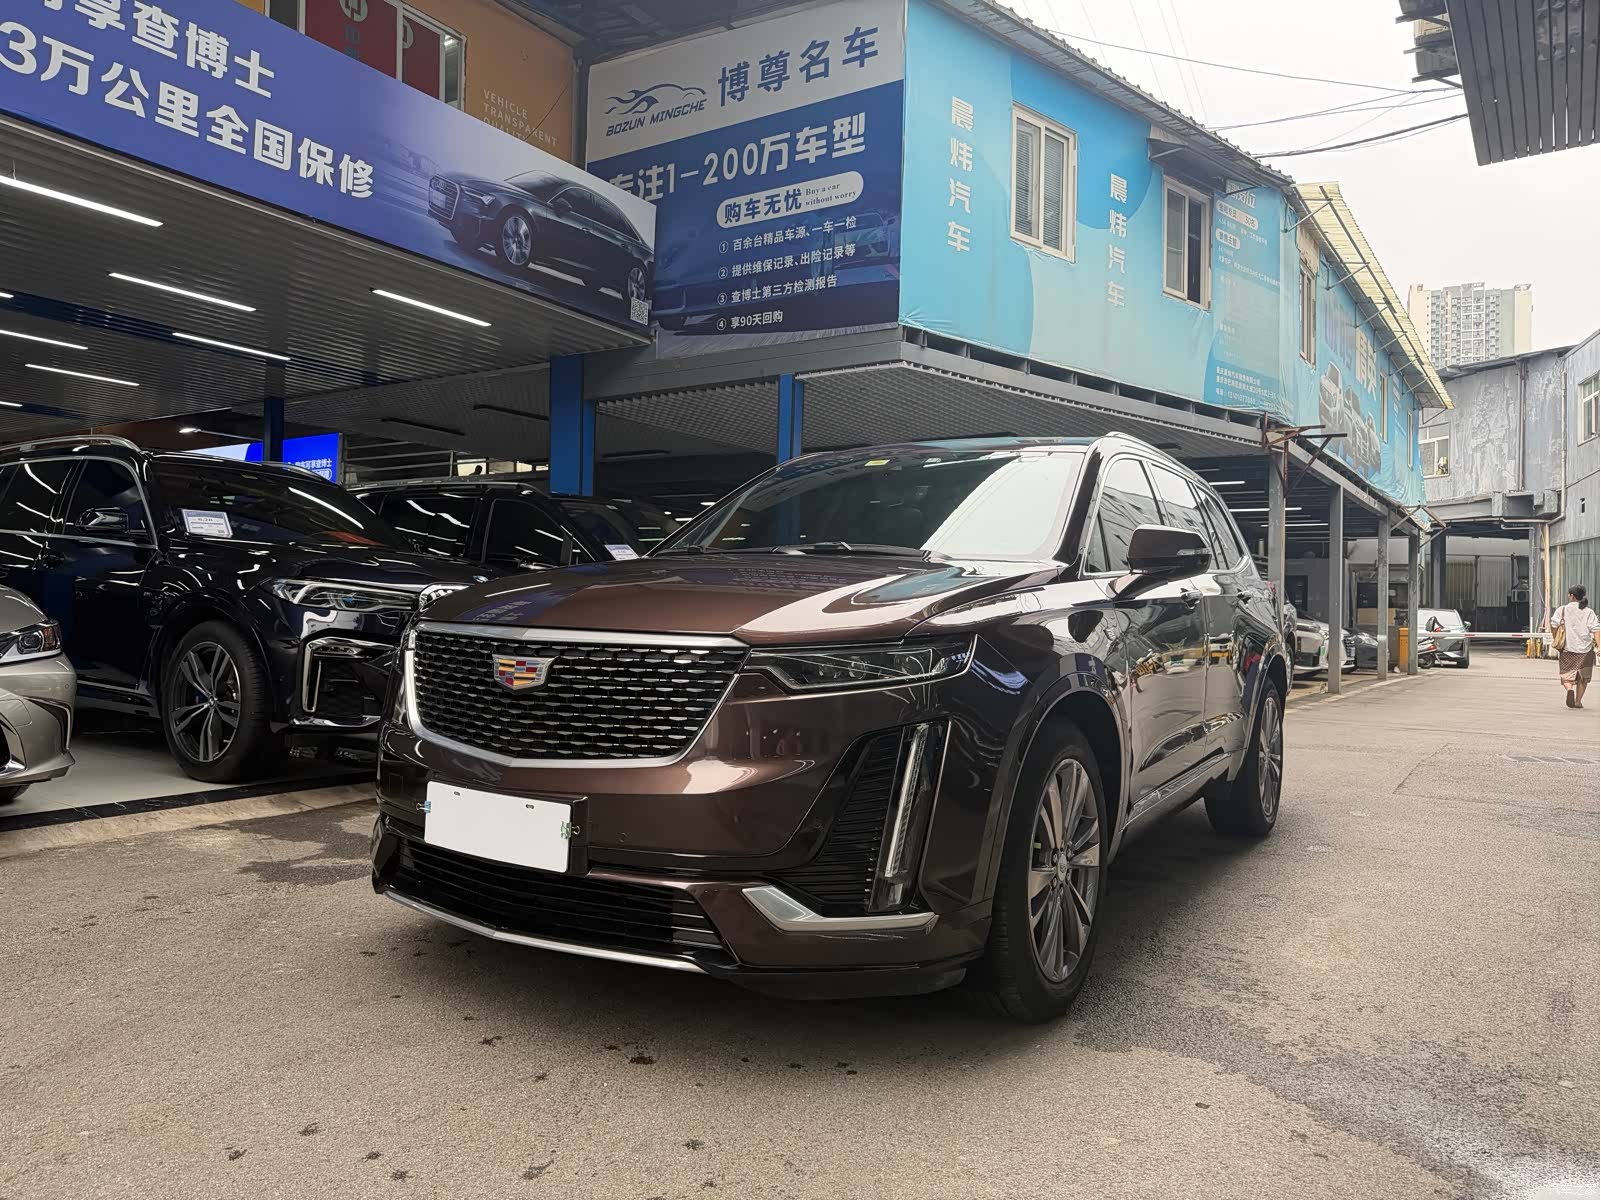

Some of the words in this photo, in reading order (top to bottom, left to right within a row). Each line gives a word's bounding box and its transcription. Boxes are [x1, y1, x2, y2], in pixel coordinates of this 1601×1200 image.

[44, 0, 275, 98] 享查博士
[718, 27, 879, 107] 博尊名车
[0, 21, 374, 199] 3万公里全国保修
[483, 87, 528, 119] VEHICLE
[606, 118, 645, 137] BOZUN
[649, 99, 707, 126] MINGCHE
[483, 102, 558, 147] TRANSPARENT
[805, 188, 820, 196] Buy
[947, 95, 974, 252] 晨炜汽车
[724, 188, 802, 224] 购车无忧
[805, 195, 833, 206] without
[834, 190, 857, 201] worry
[1107, 173, 1128, 308] 晨炜汽车
[731, 275, 837, 304] 查博士第三方检测报告
[730, 310, 784, 329] 享90天回购
